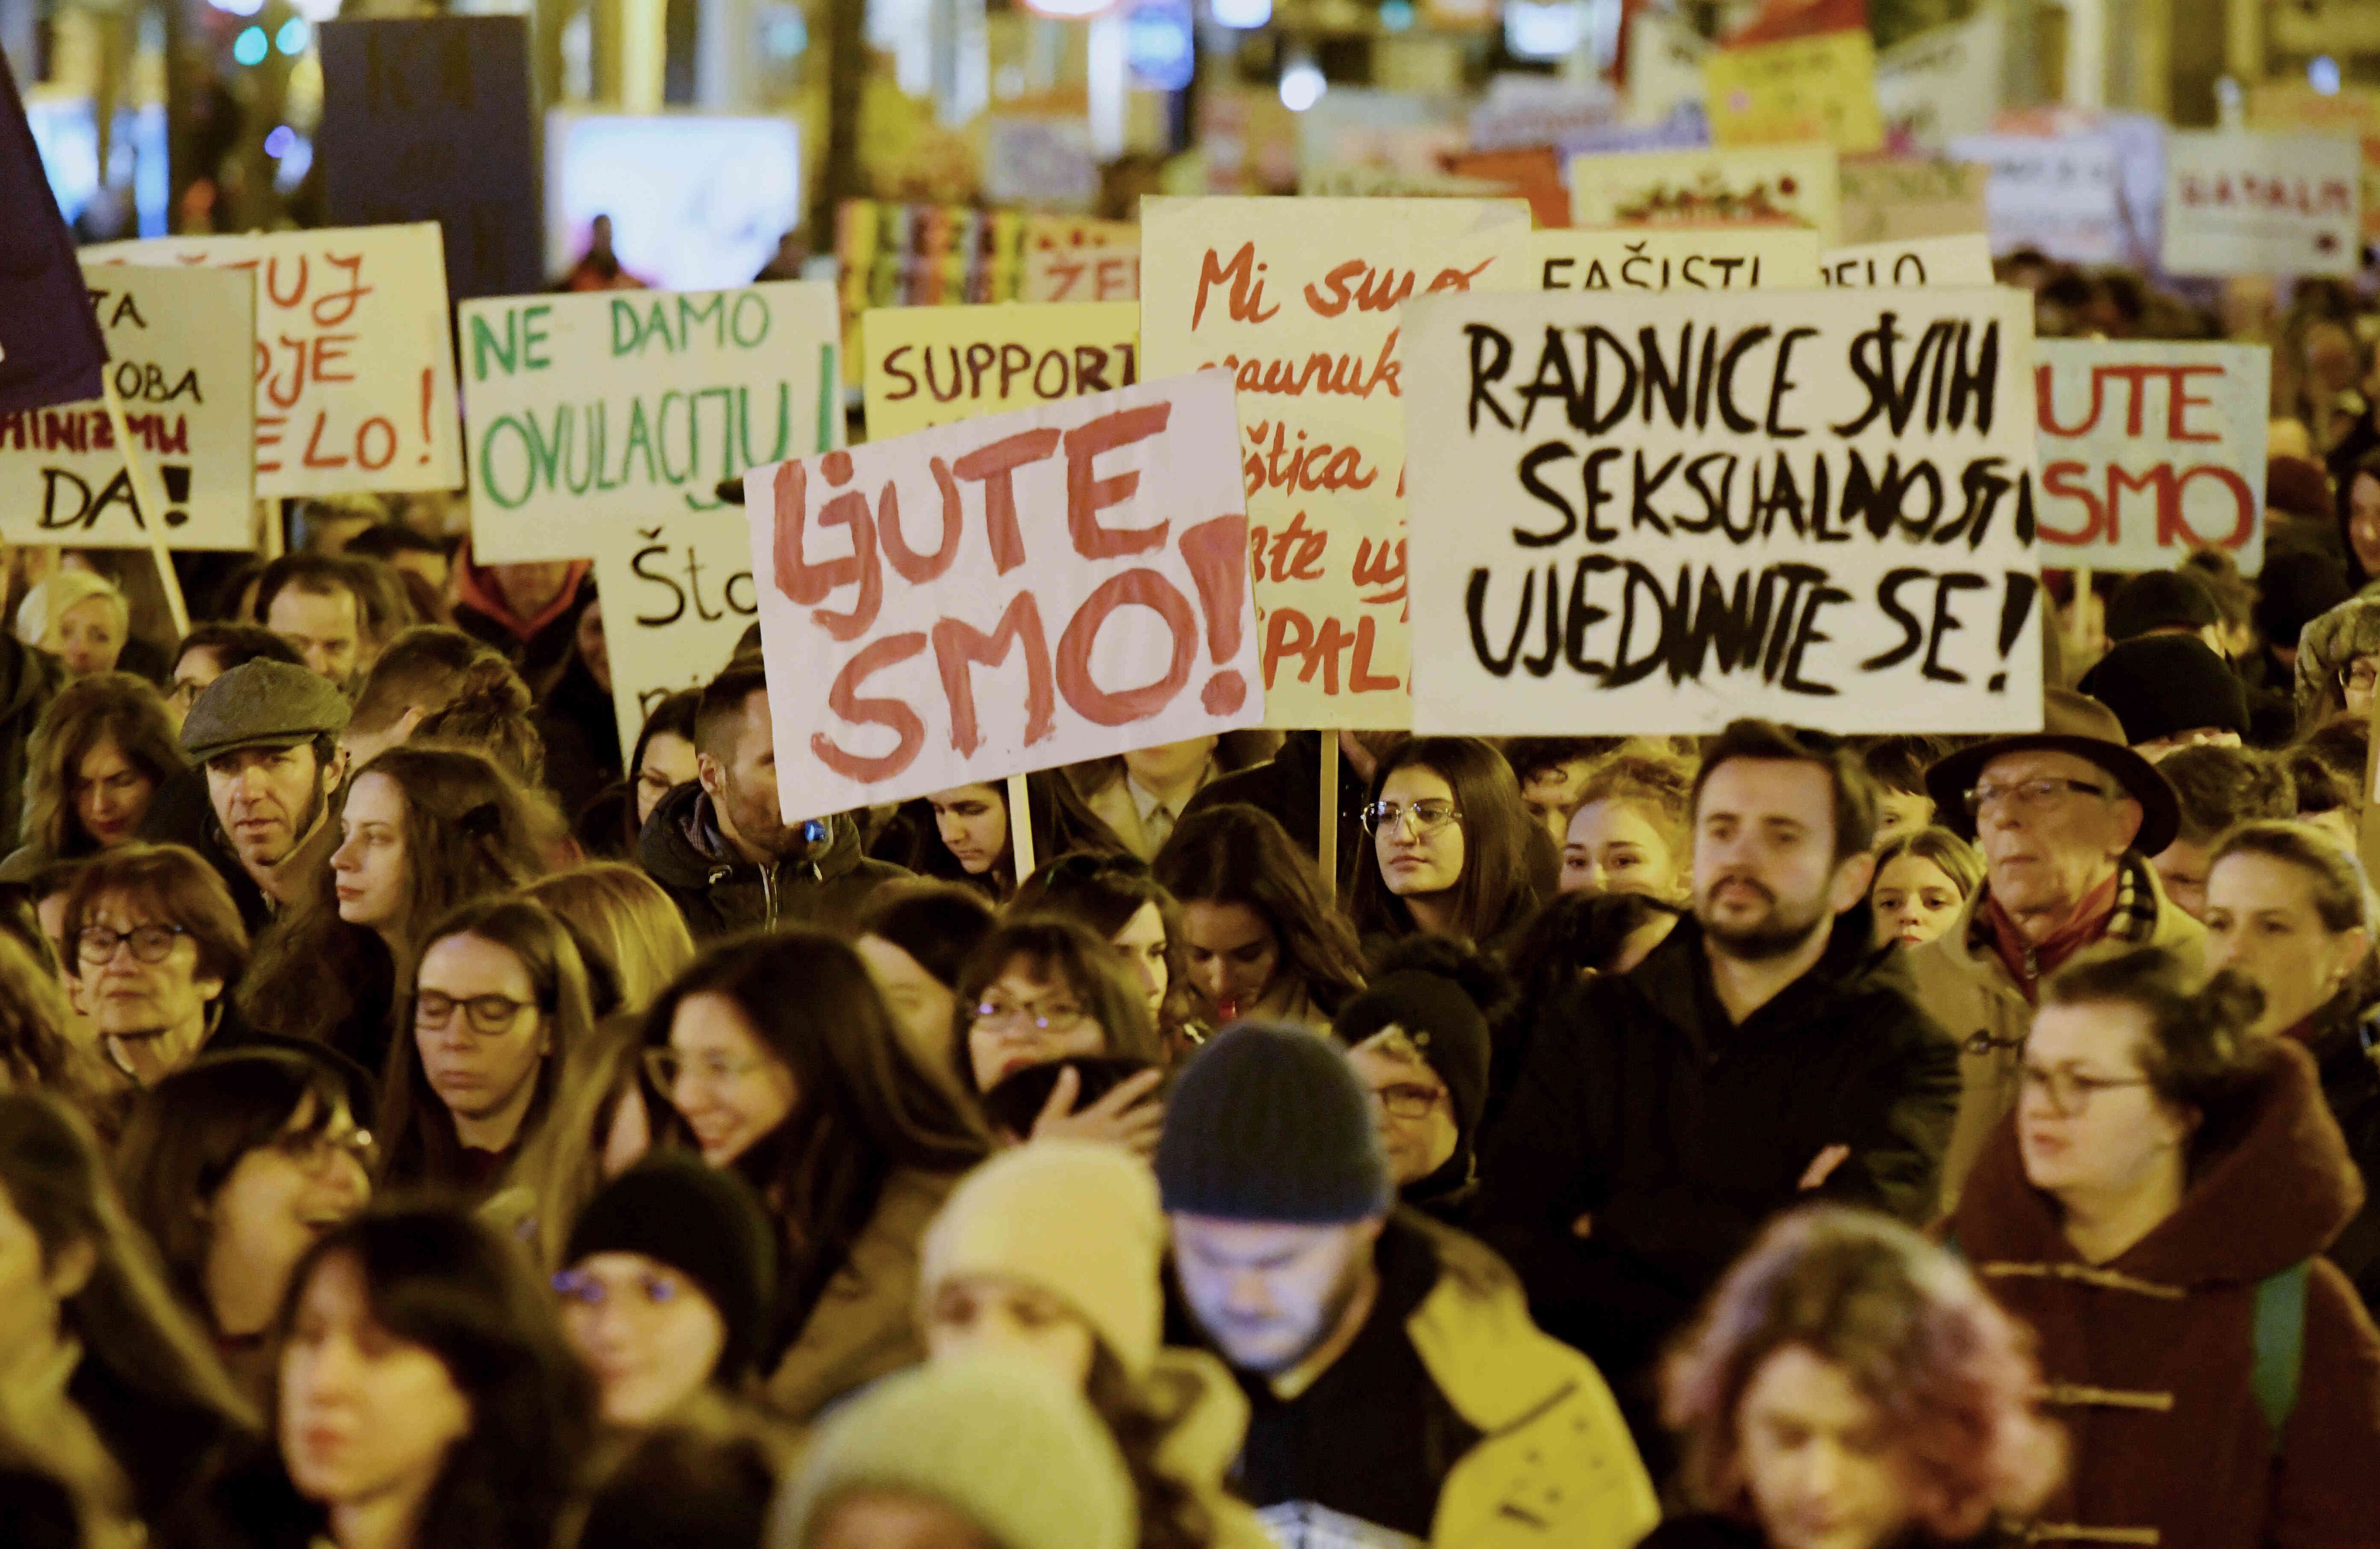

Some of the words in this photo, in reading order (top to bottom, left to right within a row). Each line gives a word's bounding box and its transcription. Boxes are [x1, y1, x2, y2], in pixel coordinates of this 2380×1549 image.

[472, 305, 552, 382] NE
[611, 291, 770, 357] DAMO
[1191, 240, 1280, 332] Mi
[1463, 322, 1821, 437] RADNICE
[1513, 440, 2035, 552] SEKSUALNOSTI
[2036, 461, 2256, 551] SMO
[631, 526, 758, 629] Što
[810, 513, 1247, 784] SMO!
[1259, 604, 1411, 696] PAL
[1859, 569, 2037, 694] SE!
